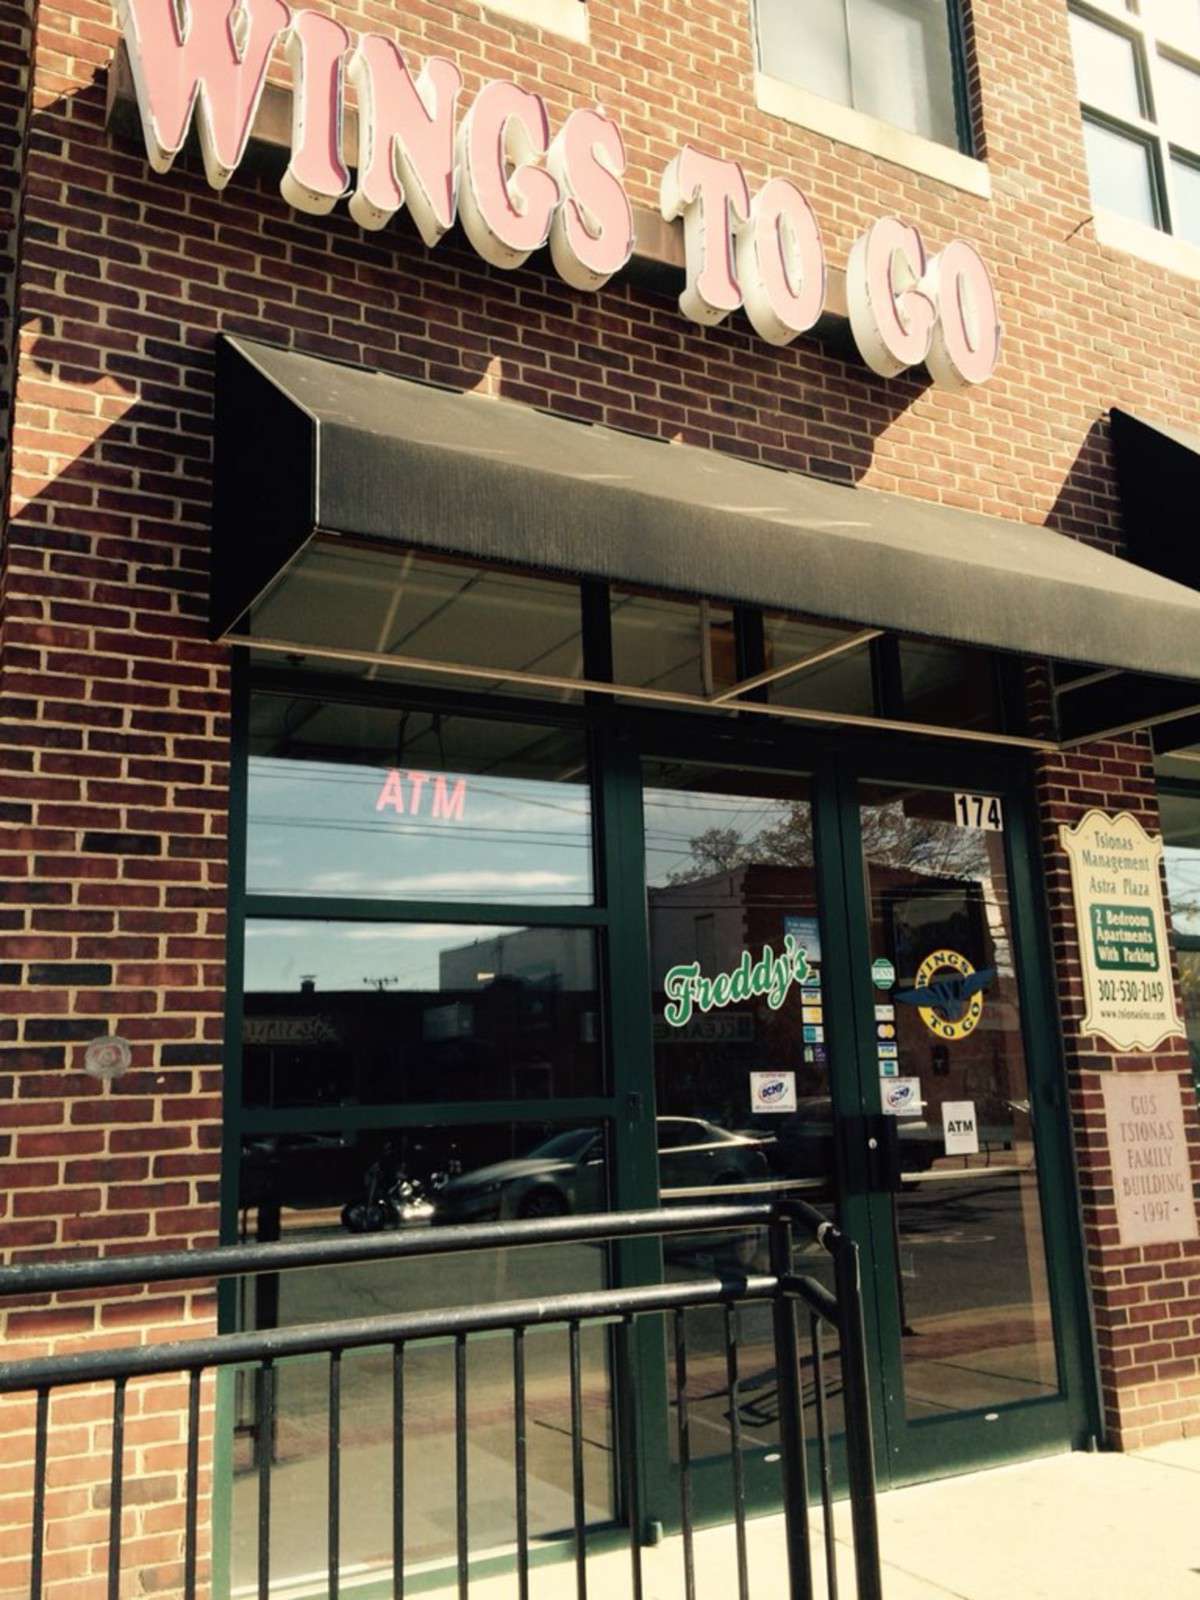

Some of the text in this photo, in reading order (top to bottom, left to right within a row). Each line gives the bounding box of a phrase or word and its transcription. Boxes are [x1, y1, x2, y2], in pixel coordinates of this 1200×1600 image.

[118, 0, 1001, 386] WINGS TO GO
[375, 768, 466, 820] ATM
[957, 795, 1000, 829] 174
[1094, 831, 1134, 850] Tsionas
[1082, 849, 1150, 873] Management
[1089, 877, 1149, 896] Astra Plaza
[1095, 909, 1149, 927] 2 Bedroom
[1097, 926, 1153, 944] Apartments
[1098, 946, 1155, 967] With Parking
[665, 934, 809, 1027] Freddy's
[917, 953, 976, 986] WINGS
[1098, 979, 1164, 1003] 302-530-2149
[929, 1002, 981, 1038] TO GO
[1131, 1096, 1157, 1115] GUS
[948, 1120, 973, 1132] ATM
[1120, 1121, 1176, 1143] TSIONAS
[1127, 1148, 1173, 1170] FAMILY
[1122, 1173, 1185, 1198] BUILDING
